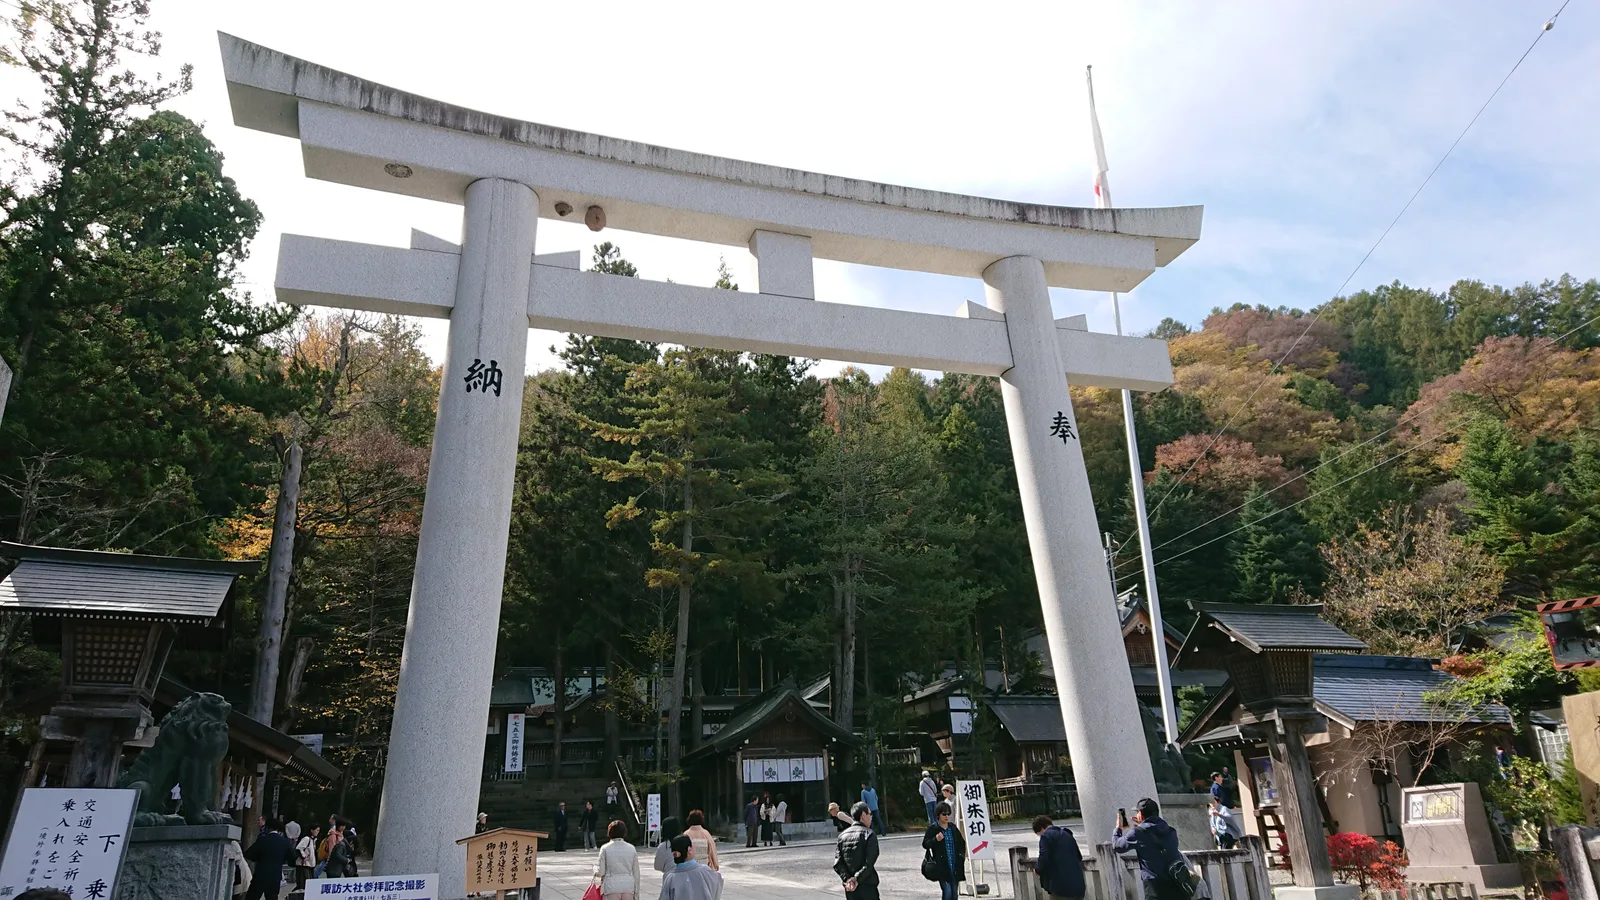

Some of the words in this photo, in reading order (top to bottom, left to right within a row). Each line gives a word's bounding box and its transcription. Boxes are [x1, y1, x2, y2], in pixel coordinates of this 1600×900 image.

[464, 359, 502, 397] 納
[1050, 411, 1076, 445] 奉
[964, 784, 985, 836] 御朱印
[84, 834, 120, 900] 下乗
[524, 844, 533, 872] お願い
[321, 880, 425, 894] 諏訪大社参拝記念撮影
